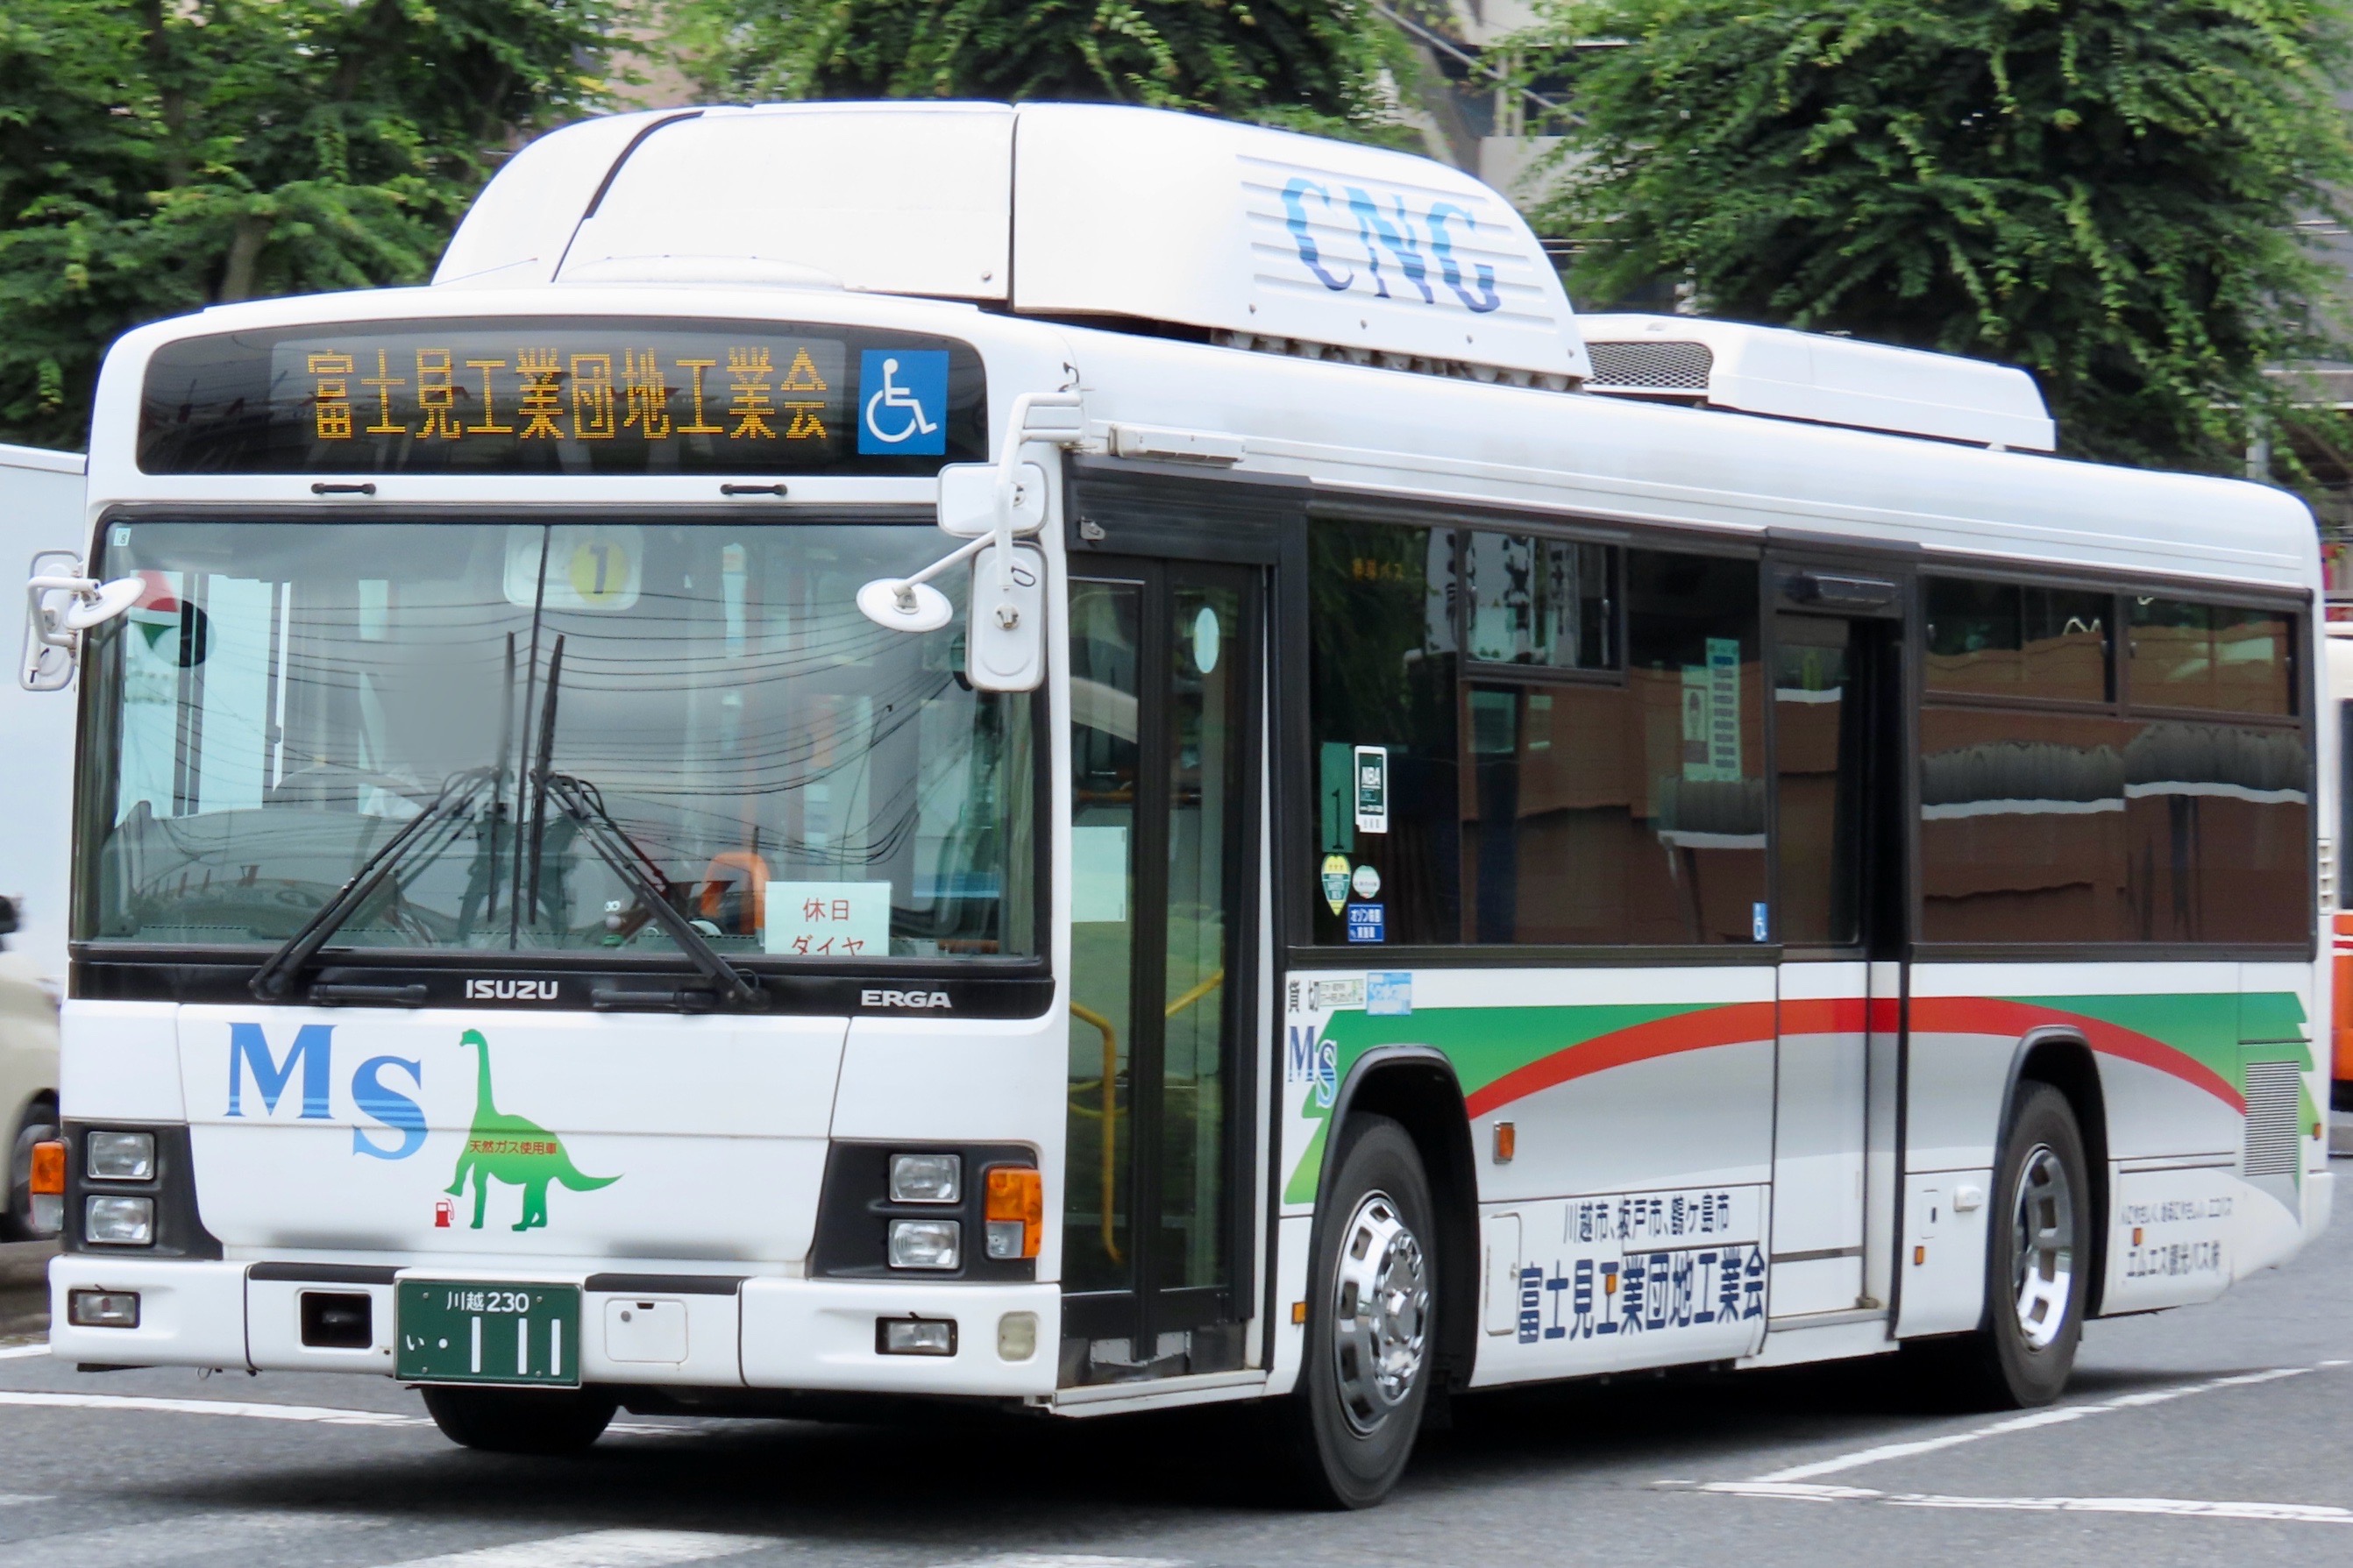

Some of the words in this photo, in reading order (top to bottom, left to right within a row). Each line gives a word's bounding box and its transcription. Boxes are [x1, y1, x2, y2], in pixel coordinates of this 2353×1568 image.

[1281, 177, 1502, 313] CNG
[307, 347, 828, 440] 富士見工業団地工業会
[802, 898, 850, 922] 休日
[791, 934, 864, 956] ダイヤ
[465, 979, 558, 1000] ISUZU
[860, 990, 953, 1009] ERGA
[1287, 1025, 1338, 1109] MS
[223, 1022, 430, 1160] MS
[469, 1139, 558, 1155] 天然ガス使用車
[446, 1290, 530, 1313] 川越230
[1518, 1245, 1766, 1344] 富士見工業団地工業会
